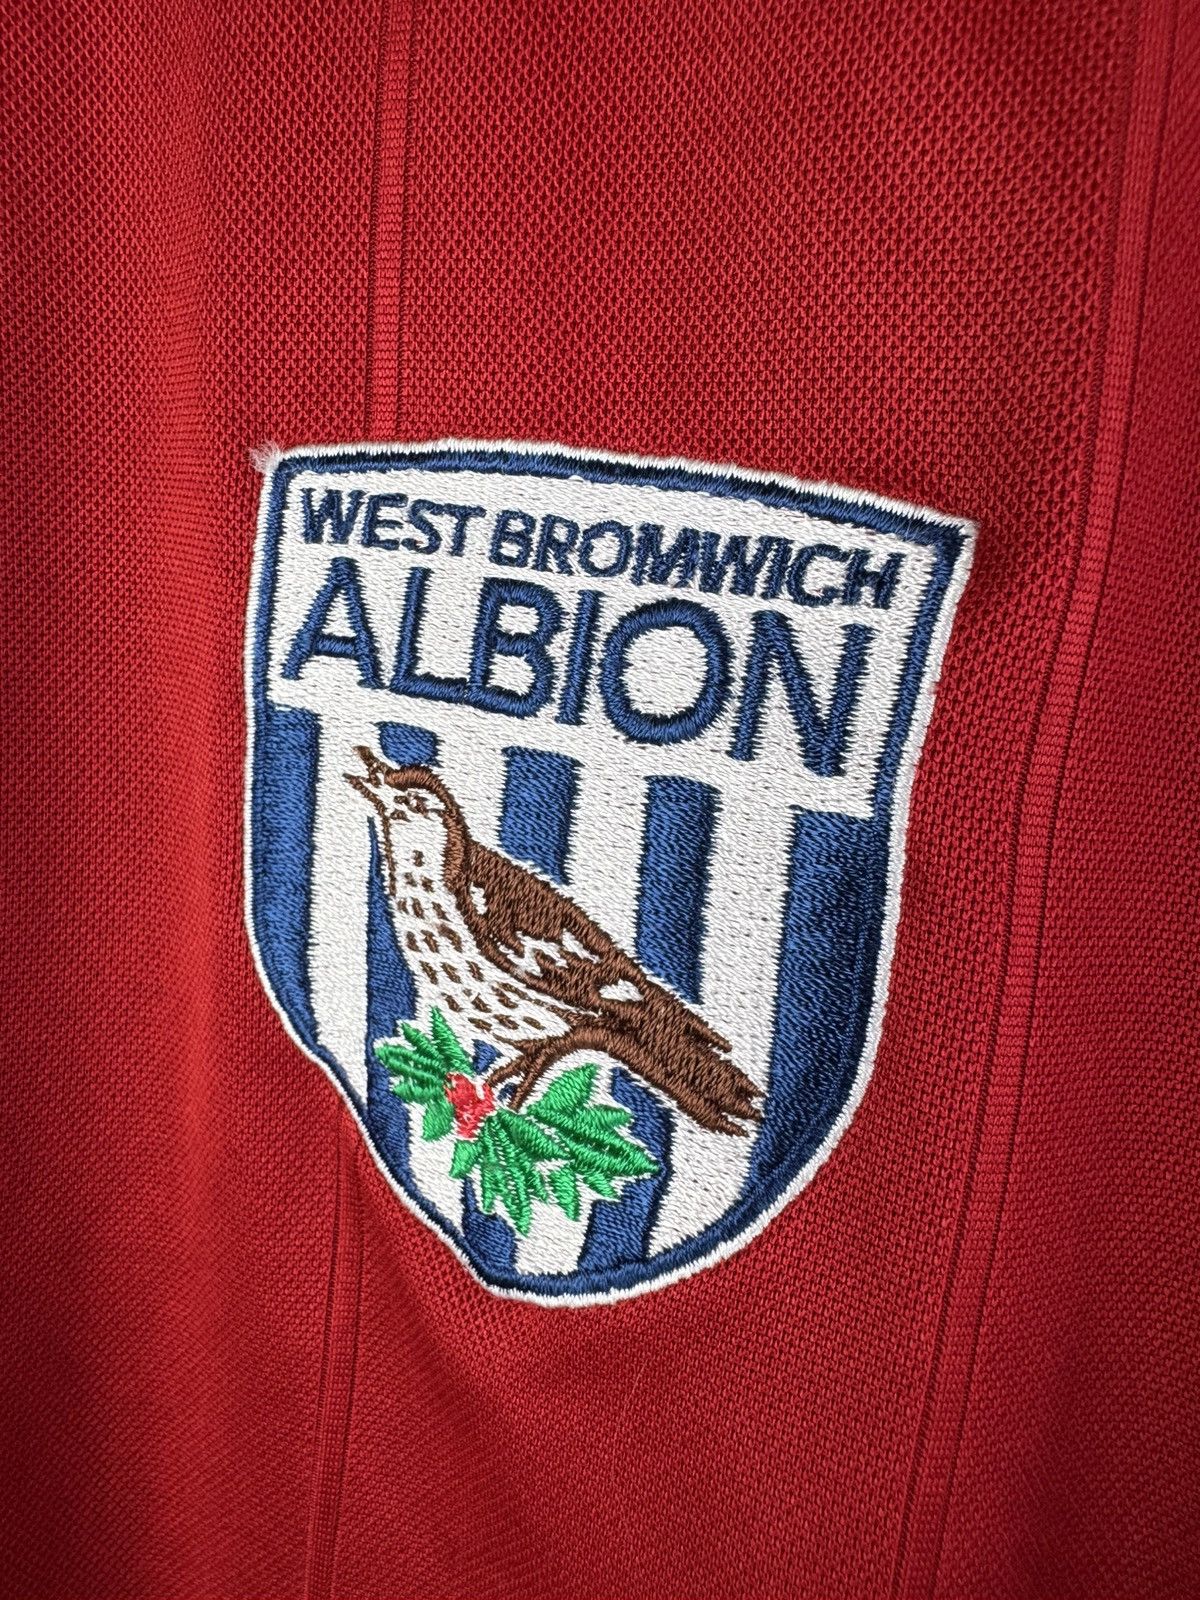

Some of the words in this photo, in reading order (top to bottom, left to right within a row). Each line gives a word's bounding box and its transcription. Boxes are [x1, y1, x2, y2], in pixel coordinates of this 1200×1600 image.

[301, 488, 485, 555] WEST
[489, 510, 902, 609] BROMWICH
[282, 556, 872, 777] ALBION
